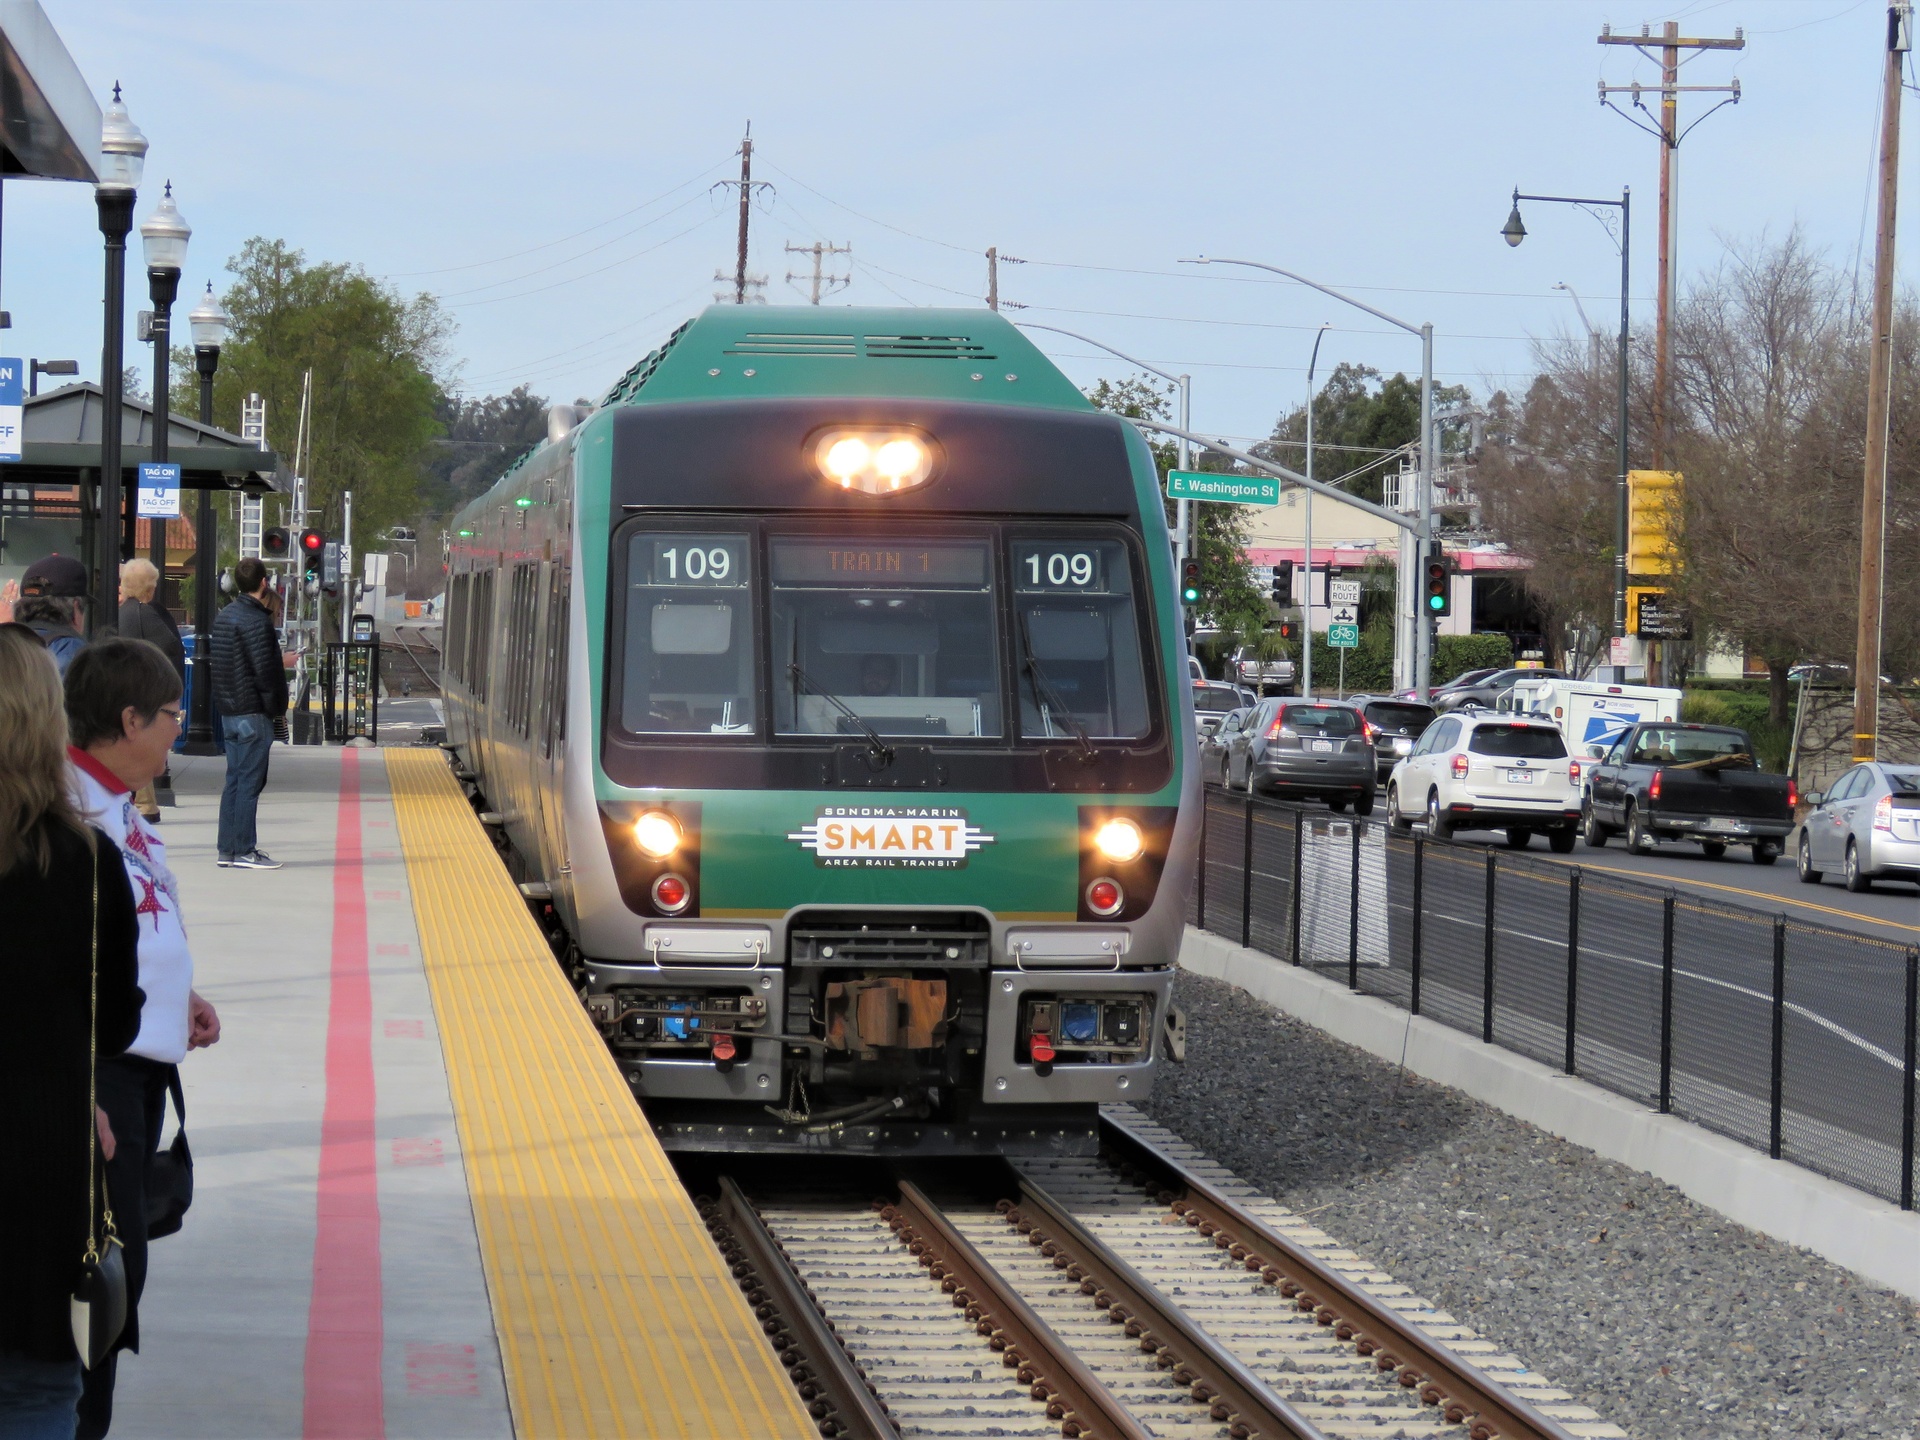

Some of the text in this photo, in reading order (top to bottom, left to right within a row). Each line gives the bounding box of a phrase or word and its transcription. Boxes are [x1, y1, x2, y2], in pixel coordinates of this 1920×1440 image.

[1174, 479, 1274, 496] E. Washington St
[663, 548, 730, 579] 109
[829, 551, 928, 572] TRAIN 1
[1025, 553, 1092, 585] 109
[1332, 584, 1358, 592] TRUCK
[824, 824, 959, 851] SMART
